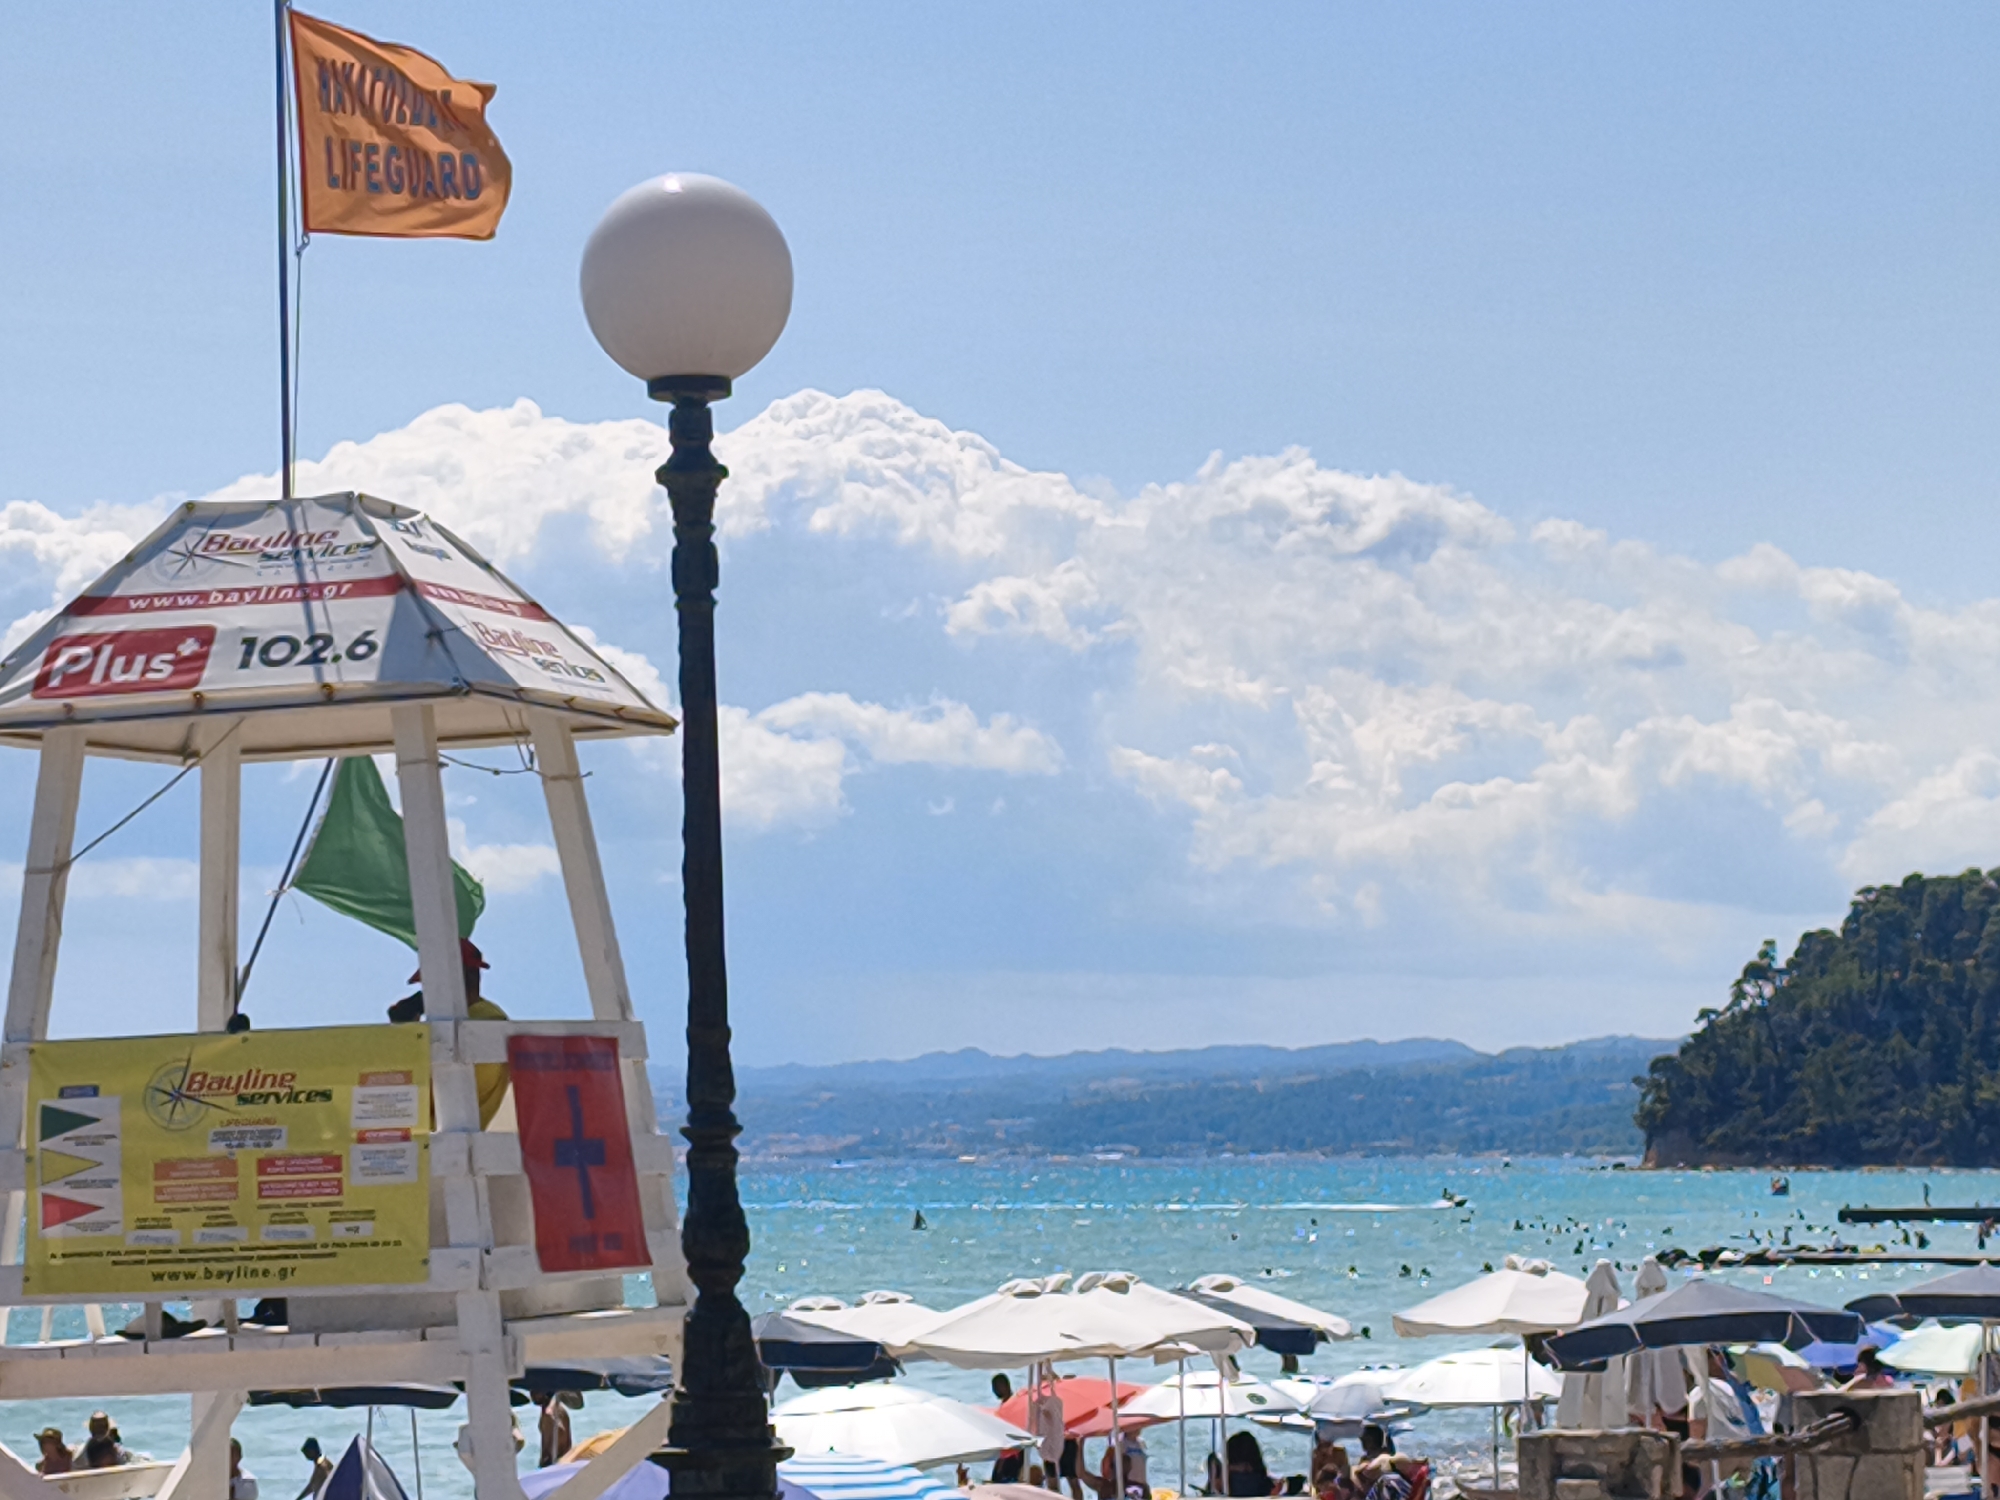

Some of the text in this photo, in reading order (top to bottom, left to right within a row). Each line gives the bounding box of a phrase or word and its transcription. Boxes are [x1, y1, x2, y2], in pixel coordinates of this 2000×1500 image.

[324, 136, 482, 201] LIFEGUARD
[201, 529, 340, 556] Bayline
[129, 581, 353, 610] www.bayline.gr
[237, 629, 380, 671] 102.6
[186, 1067, 298, 1097] Bayline
[234, 1085, 333, 1106] services
[151, 1264, 298, 1283] www.bayline.gr
